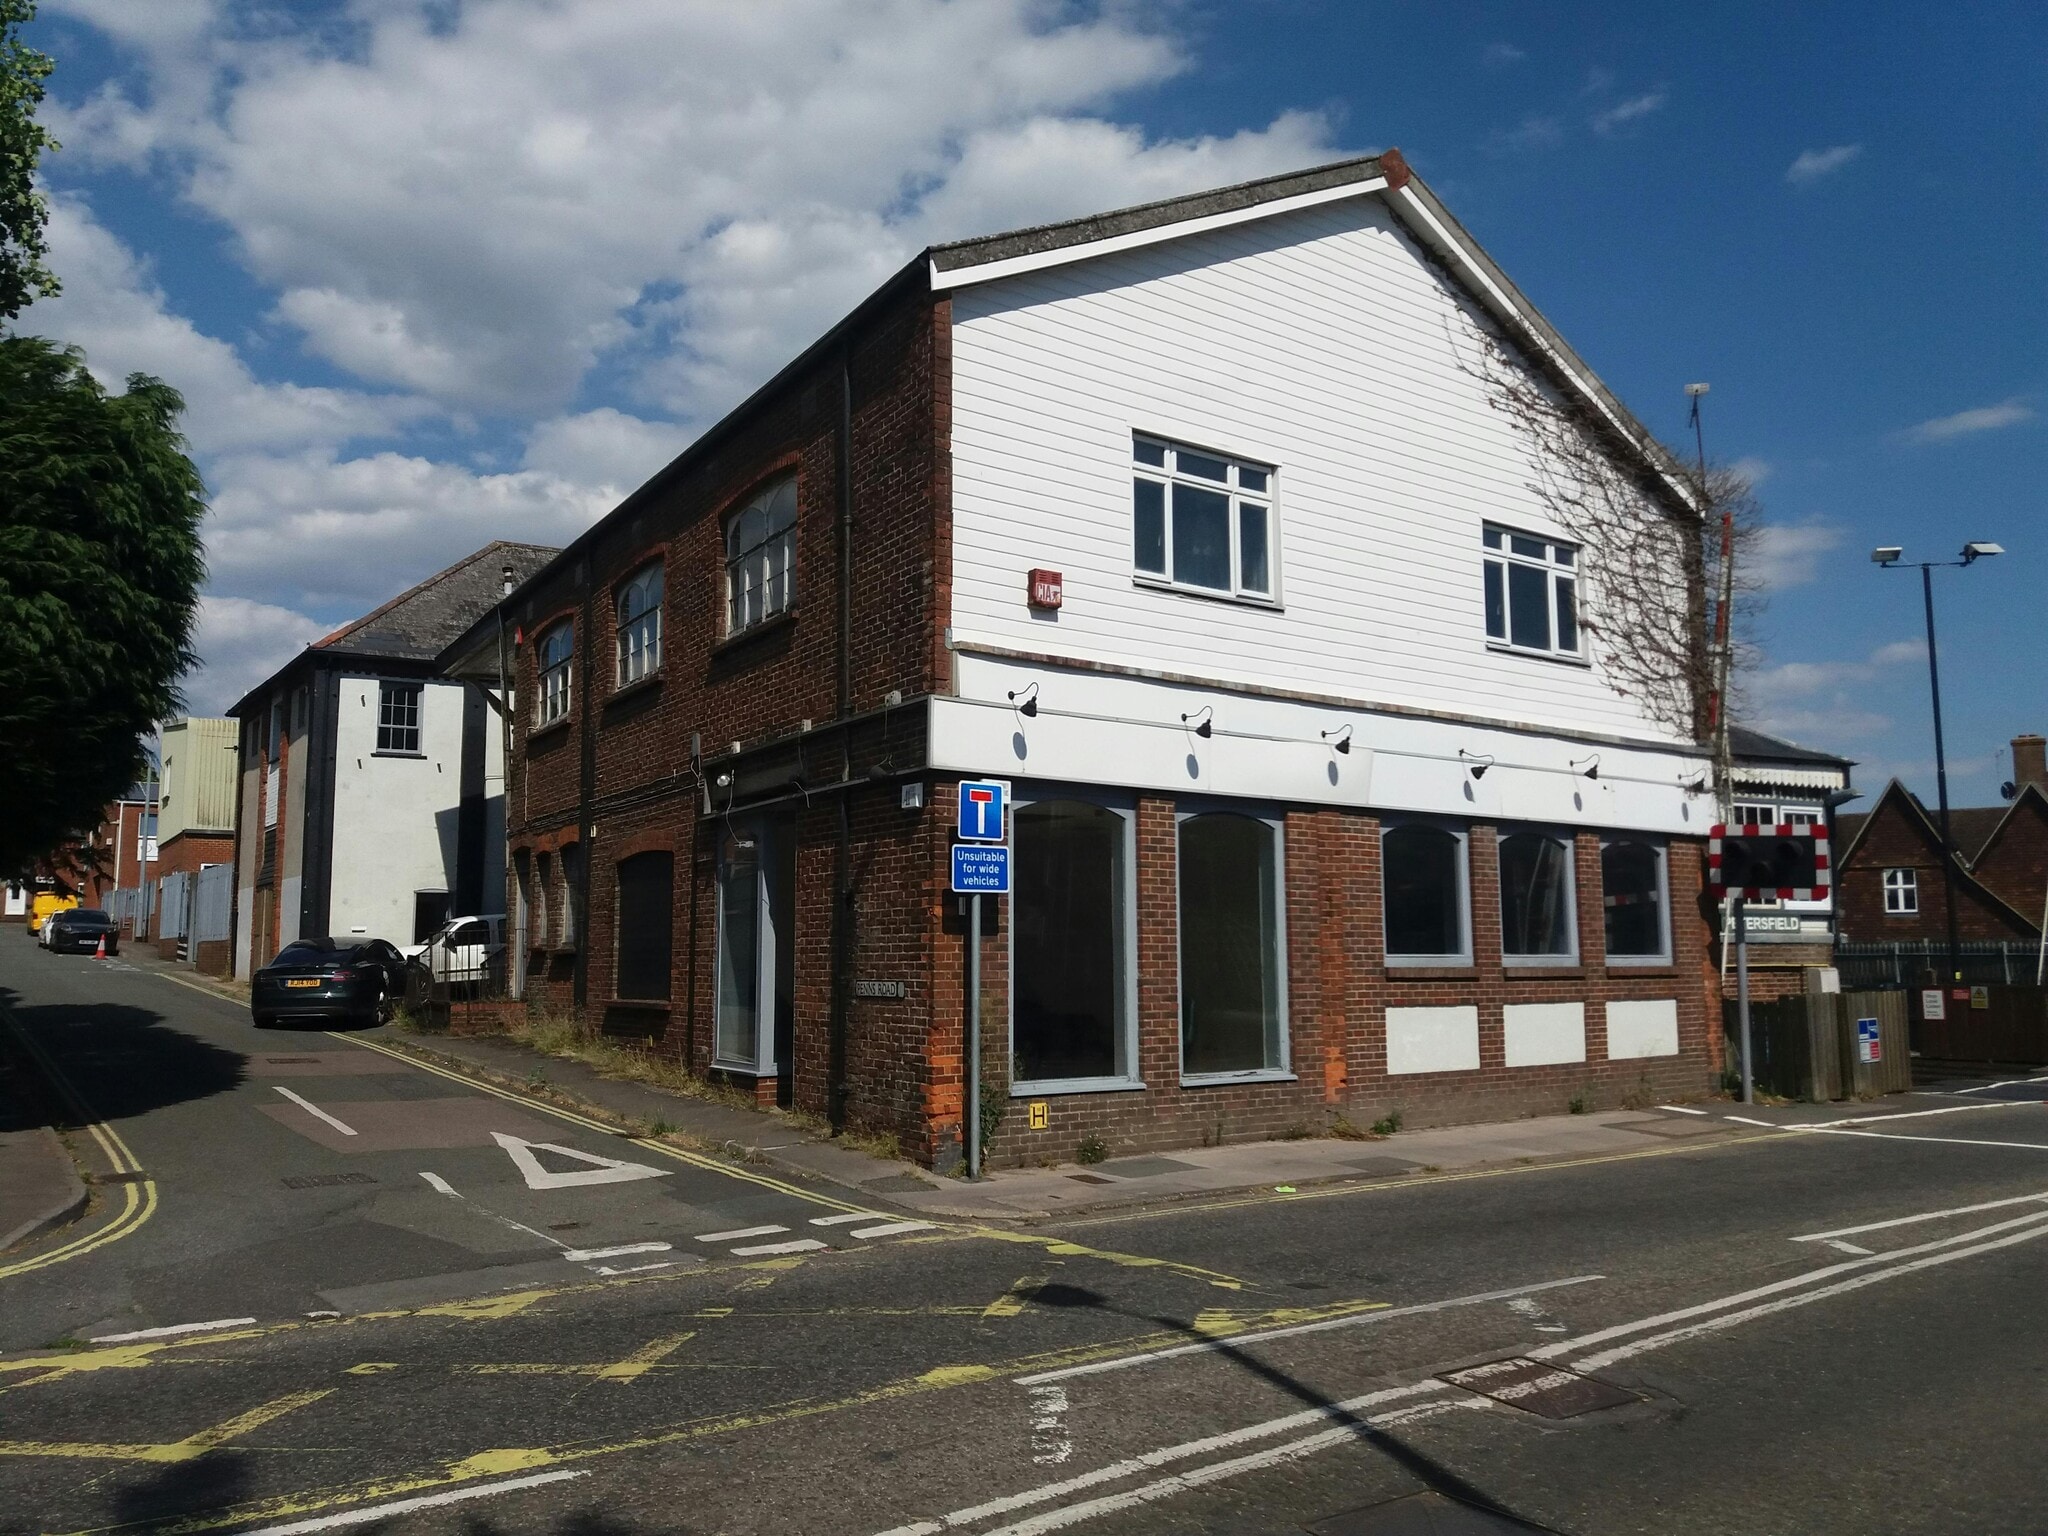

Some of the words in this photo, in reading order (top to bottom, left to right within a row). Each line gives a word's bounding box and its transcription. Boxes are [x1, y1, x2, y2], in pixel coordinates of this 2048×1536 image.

[957, 850, 1005, 862] Unsuitable
[963, 862, 976, 873] for
[979, 863, 1000, 874] wide
[963, 875, 999, 886] vehicles
[877, 983, 896, 995] ROAD
[1032, 1105, 1045, 1127] H
